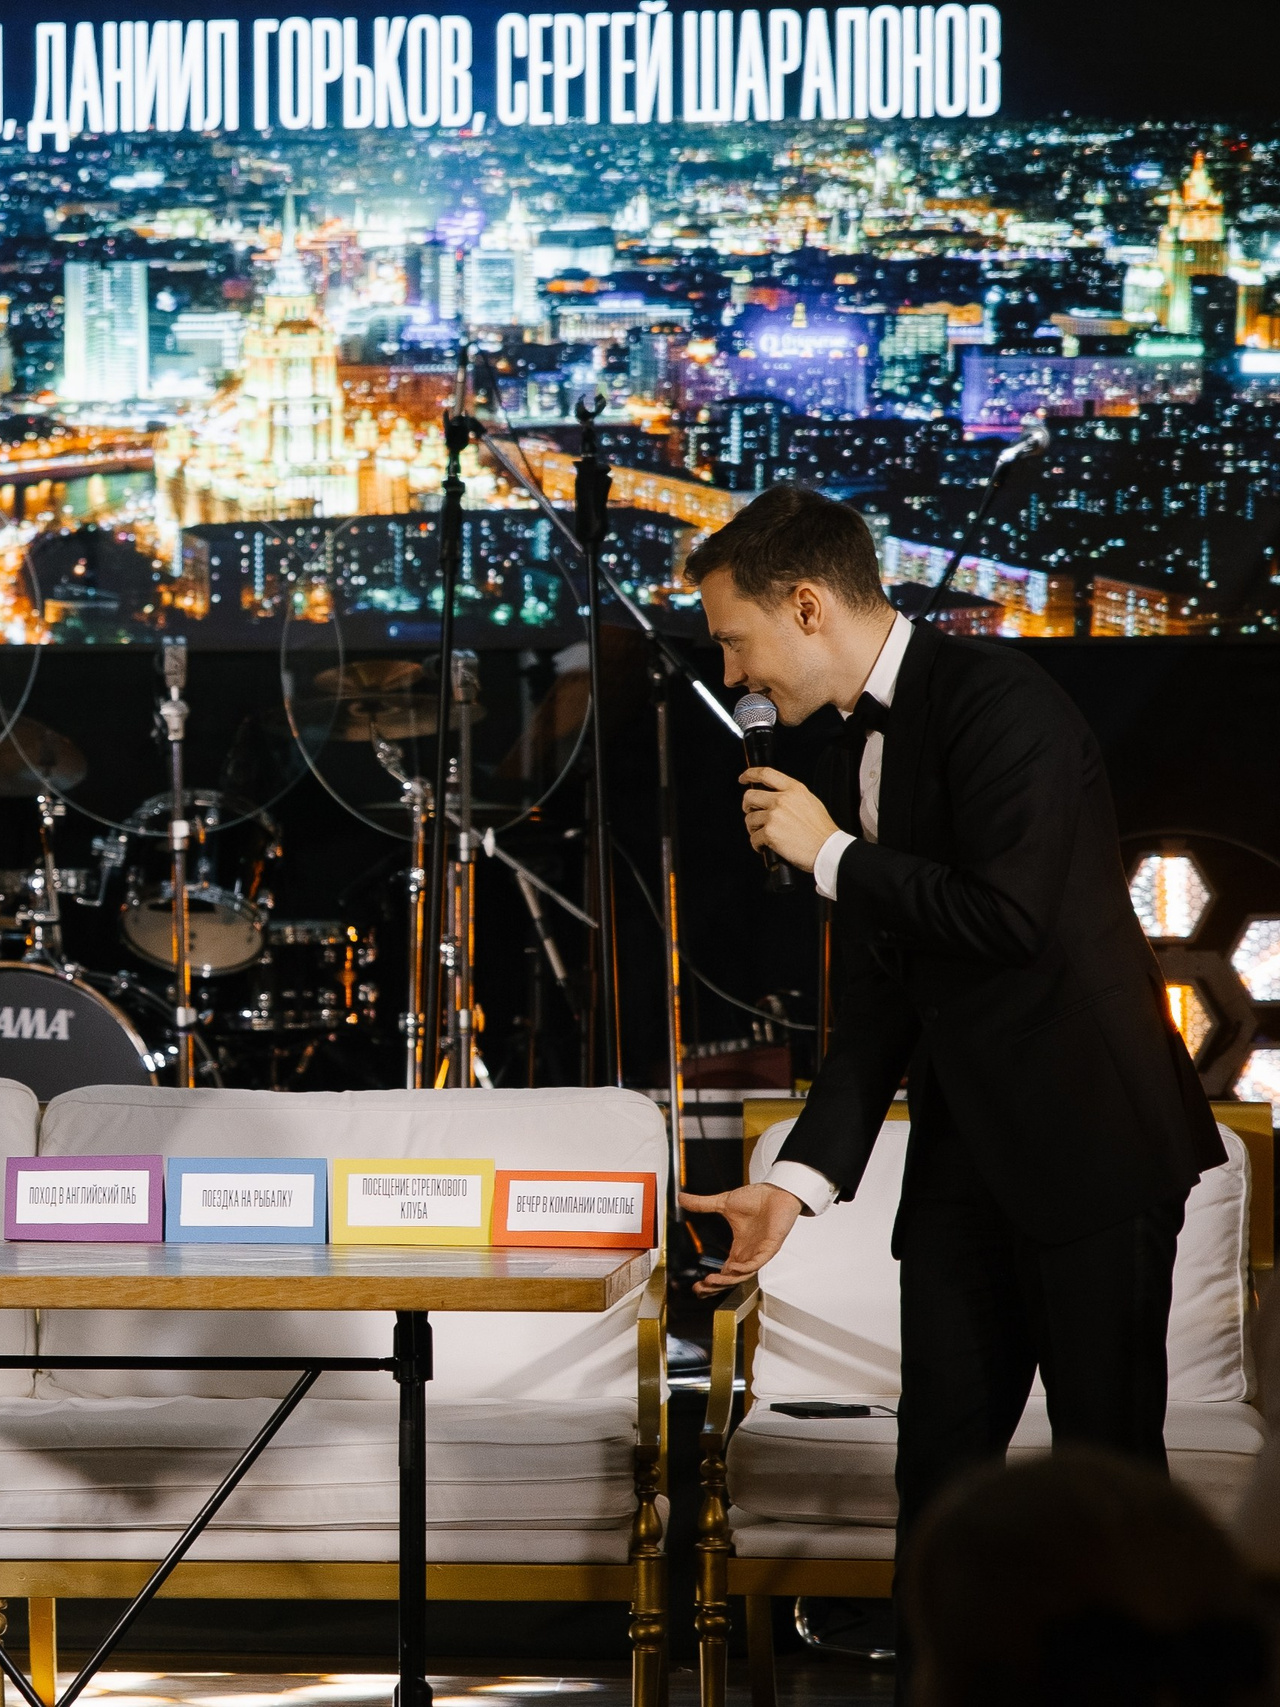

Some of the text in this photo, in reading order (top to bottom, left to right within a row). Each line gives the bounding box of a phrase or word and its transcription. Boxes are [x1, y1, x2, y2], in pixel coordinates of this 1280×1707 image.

[27, 19, 239, 153] ДАНИИЛ
[253, 14, 487, 135] ГОРЬКОВ,
[496, 0, 673, 127] СЕРГЕЙ
[679, 3, 1002, 123] ШАРАПОНОВ
[29, 1183, 137, 1207] ПОХОД В АНГЛИЙСКИЙ ПАБ
[362, 1177, 467, 1198] ПОСЕЩЕНИЕ СТРЕЛКОВОГО
[202, 1189, 293, 1210] ПОЕЗДКА НА РЫБАЛКУ
[400, 1201, 428, 1219] КЛУБА
[516, 1195, 635, 1215] ВЕЧЕР В КОМПАНИИ СОМЕЛЬЕ
